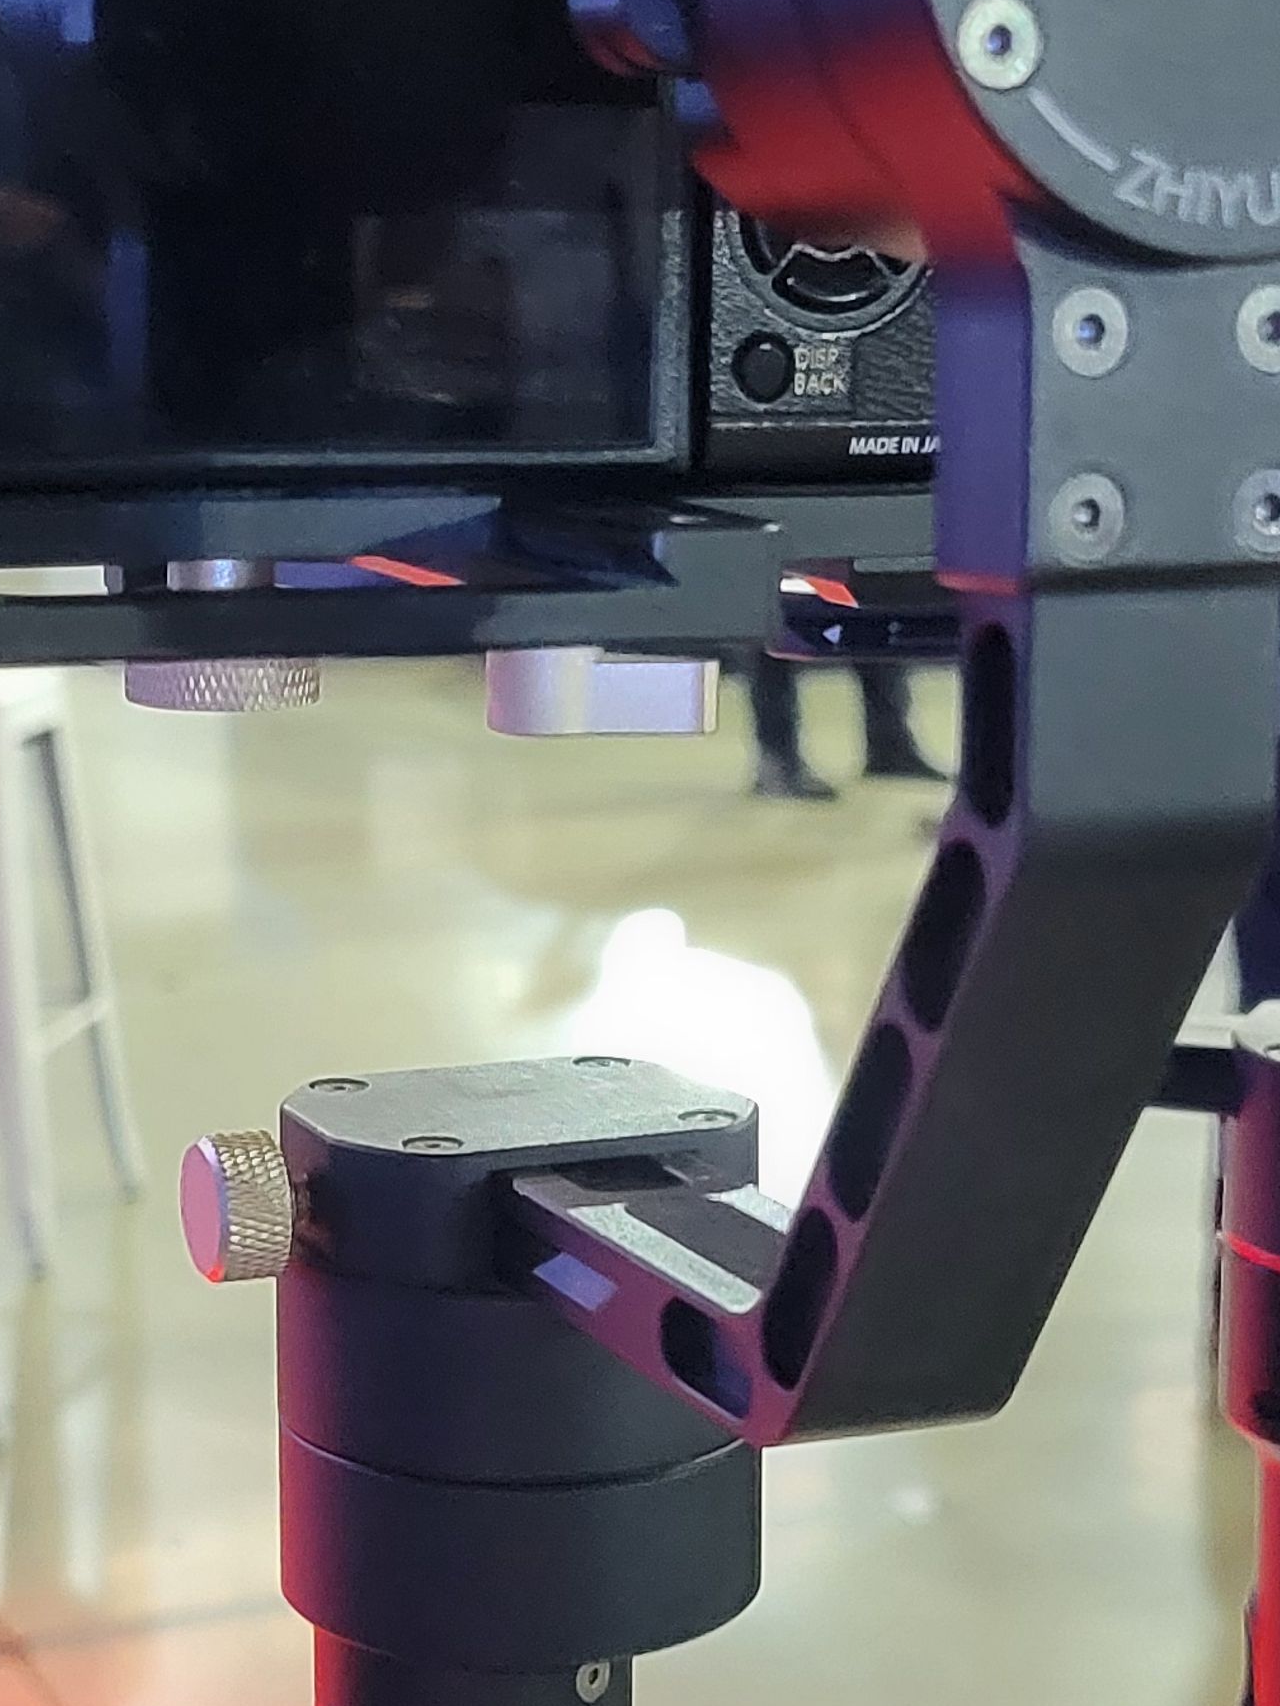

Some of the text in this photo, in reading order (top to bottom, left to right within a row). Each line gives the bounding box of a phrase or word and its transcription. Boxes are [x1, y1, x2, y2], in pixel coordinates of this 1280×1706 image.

[793, 372, 848, 396] BACK
[849, 435, 942, 455] MADE IN JA
